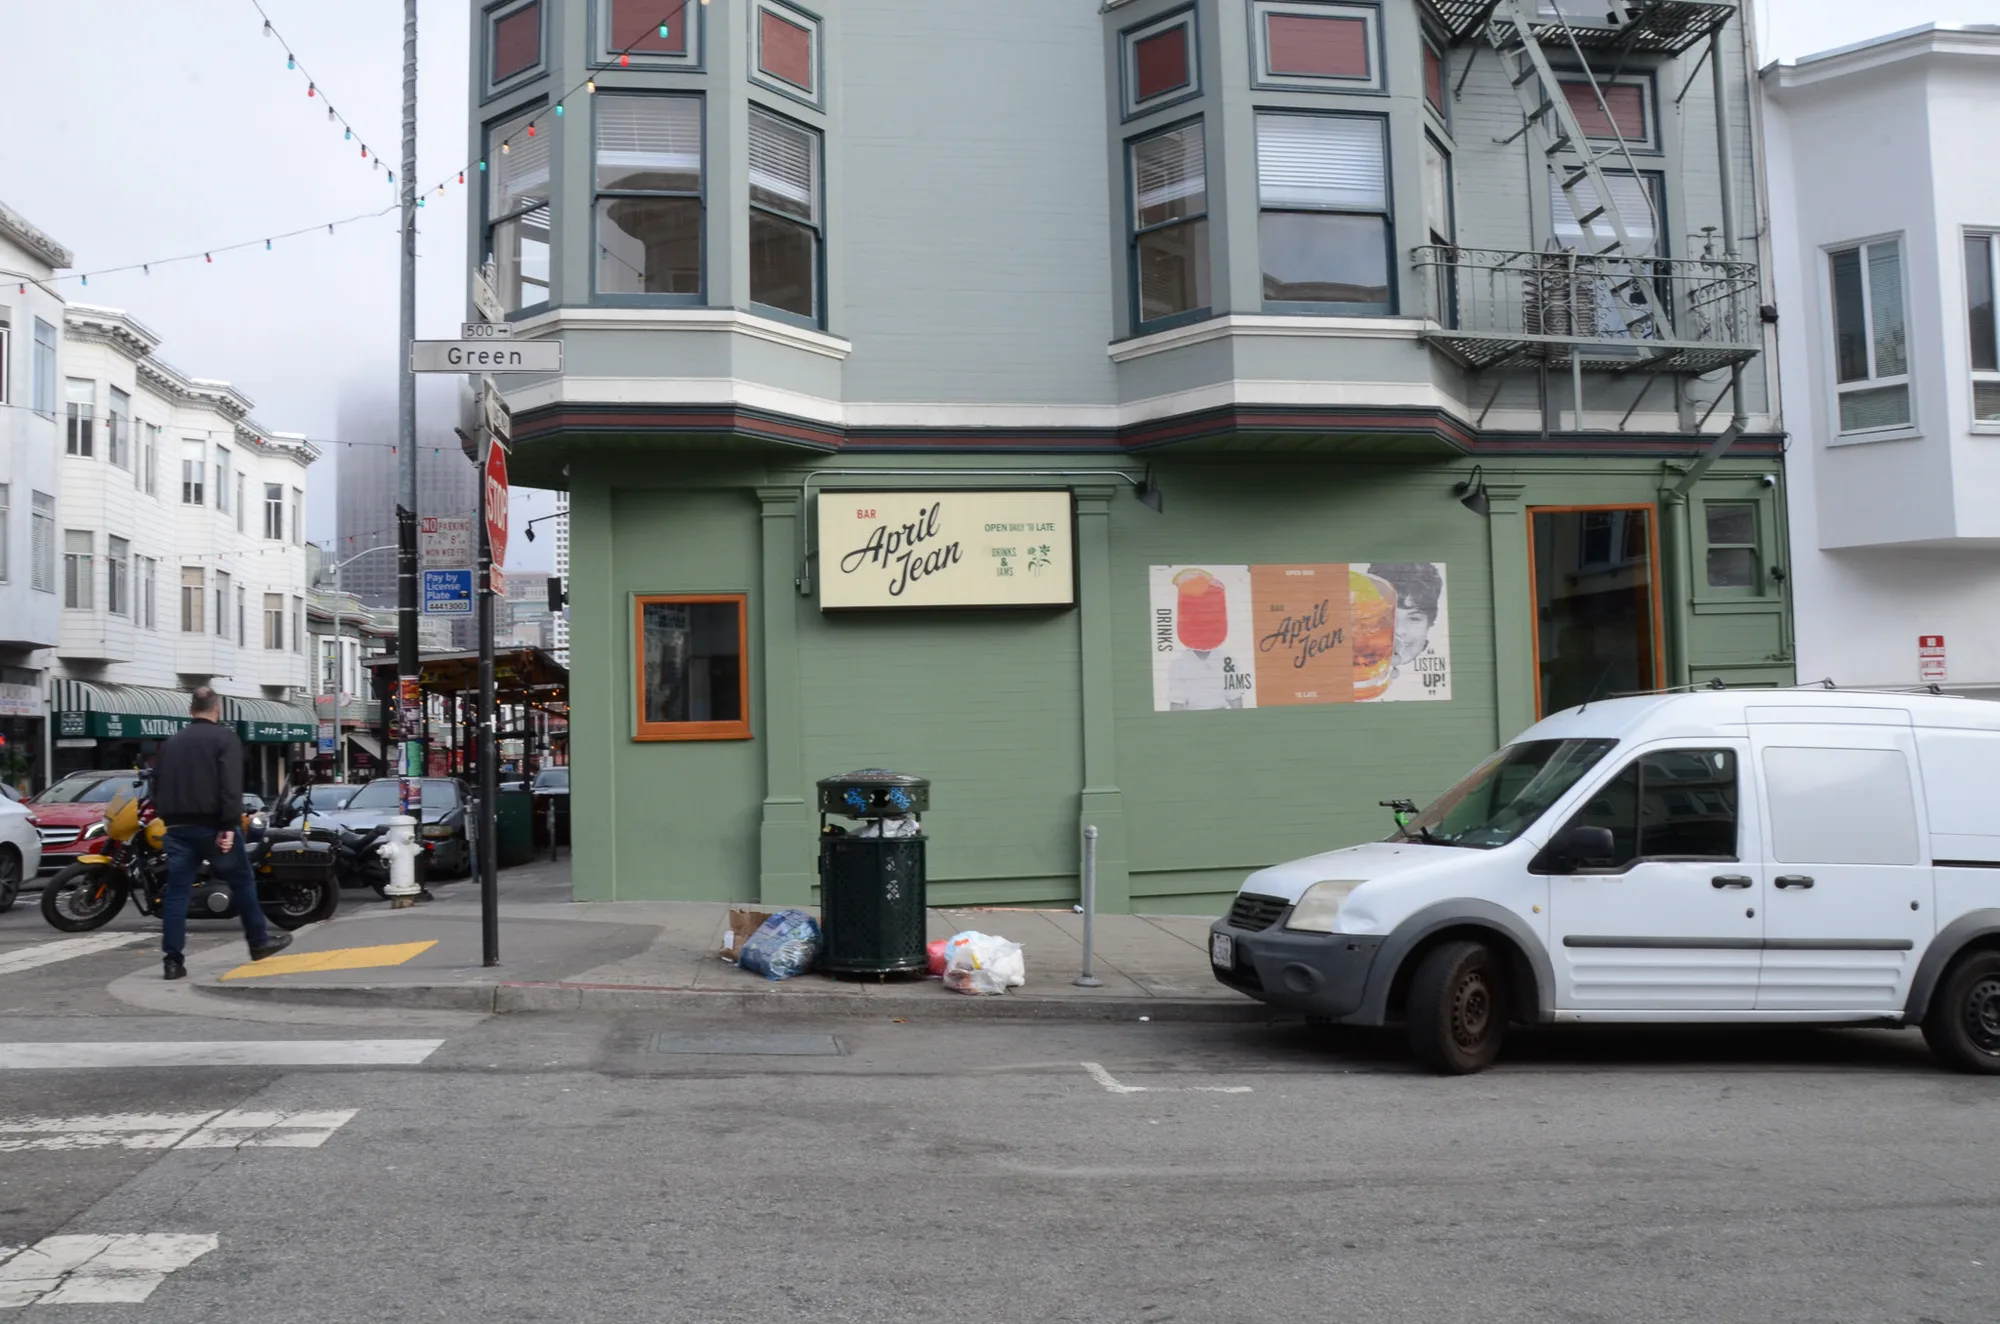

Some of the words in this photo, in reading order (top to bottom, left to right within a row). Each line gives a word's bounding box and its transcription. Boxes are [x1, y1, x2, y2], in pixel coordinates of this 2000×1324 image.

[467, 325, 494, 337] 500
[448, 347, 522, 365] Green
[487, 475, 507, 531] STOP
[856, 508, 877, 519] BAR
[423, 519, 437, 531] NO
[438, 521, 471, 531] PARKING
[984, 523, 1008, 532] OPEN
[1036, 522, 1056, 532] LATE
[840, 501, 941, 574] April
[991, 547, 1017, 557] DRINKS
[888, 541, 964, 596] Jean
[1000, 557, 1008, 567] &
[426, 573, 444, 583] Pay
[446, 572, 458, 583] by
[426, 582, 461, 591] License
[426, 591, 451, 600] Plate
[1156, 608, 1174, 652] DRINKS
[1259, 598, 1329, 653] April
[1293, 627, 1345, 669] Jean
[1223, 656, 1236, 673] &
[1413, 657, 1446, 672] LISTEN
[1223, 673, 1252, 691] JAMS
[1422, 673, 1446, 688] UP!
[140, 718, 178, 736] NATURAL
